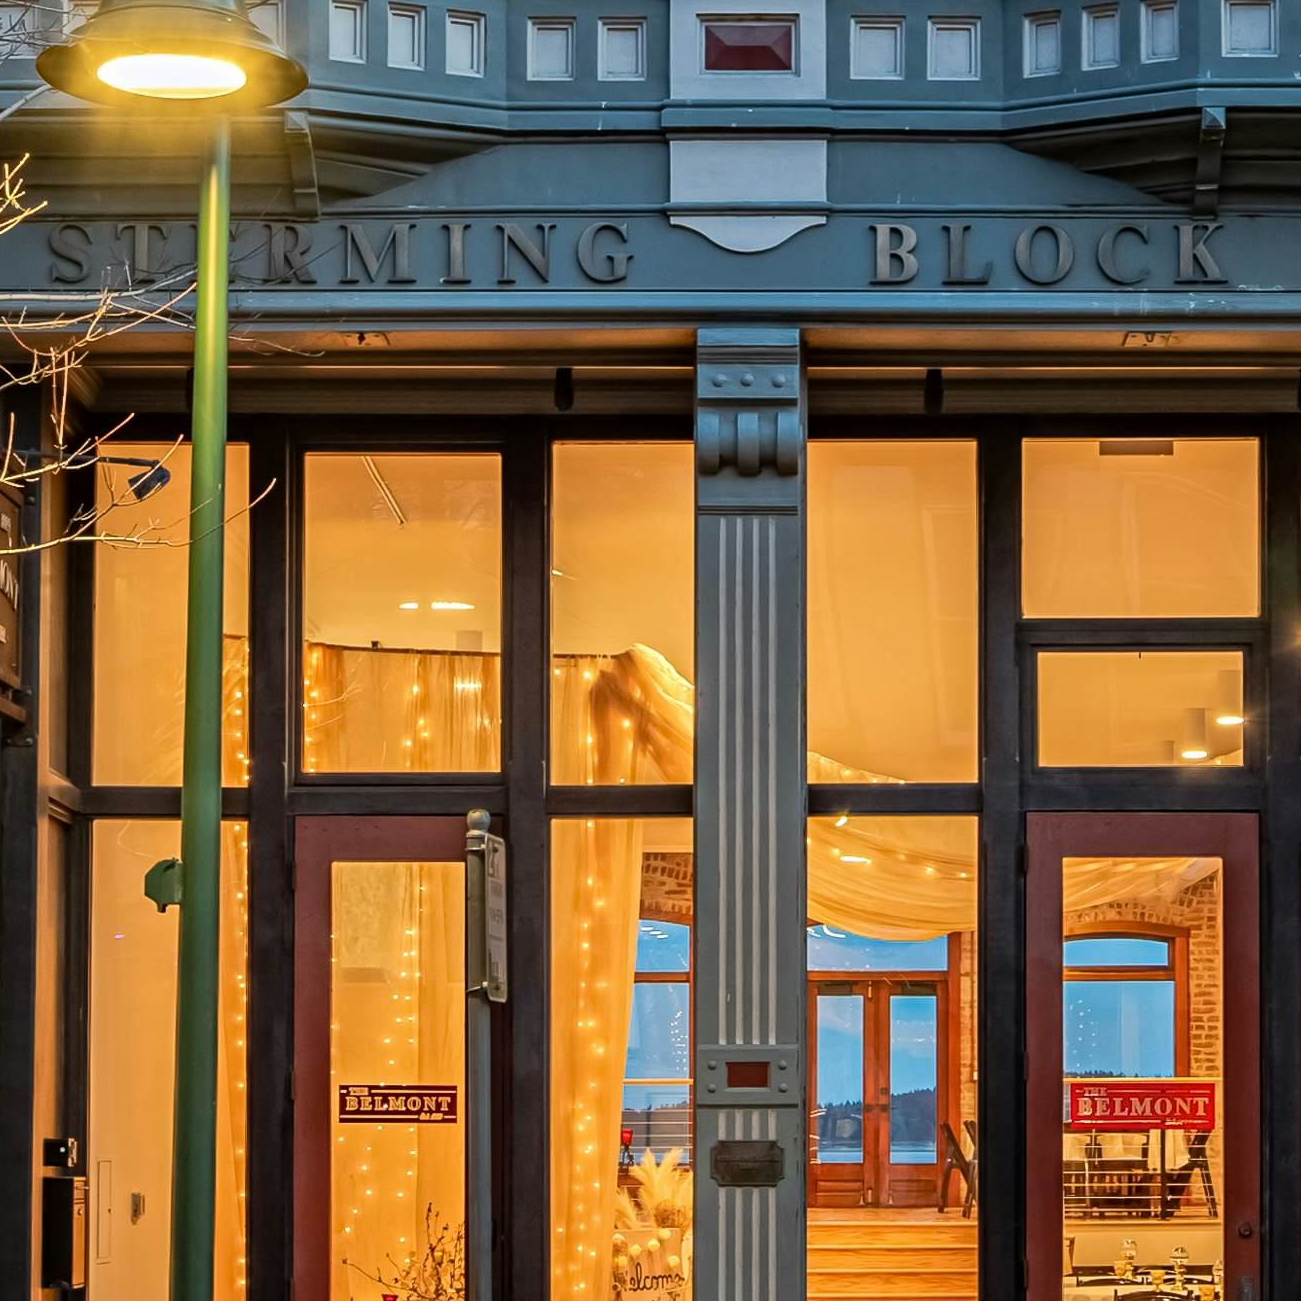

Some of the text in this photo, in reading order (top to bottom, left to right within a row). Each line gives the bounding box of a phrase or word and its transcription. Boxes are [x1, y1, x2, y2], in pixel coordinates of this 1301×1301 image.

[867, 222, 1229, 286] BLOCK
[1083, 1086, 1108, 1097] THE
[345, 1096, 452, 1111] BELMONT
[1076, 1097, 1210, 1117] BELMONT
